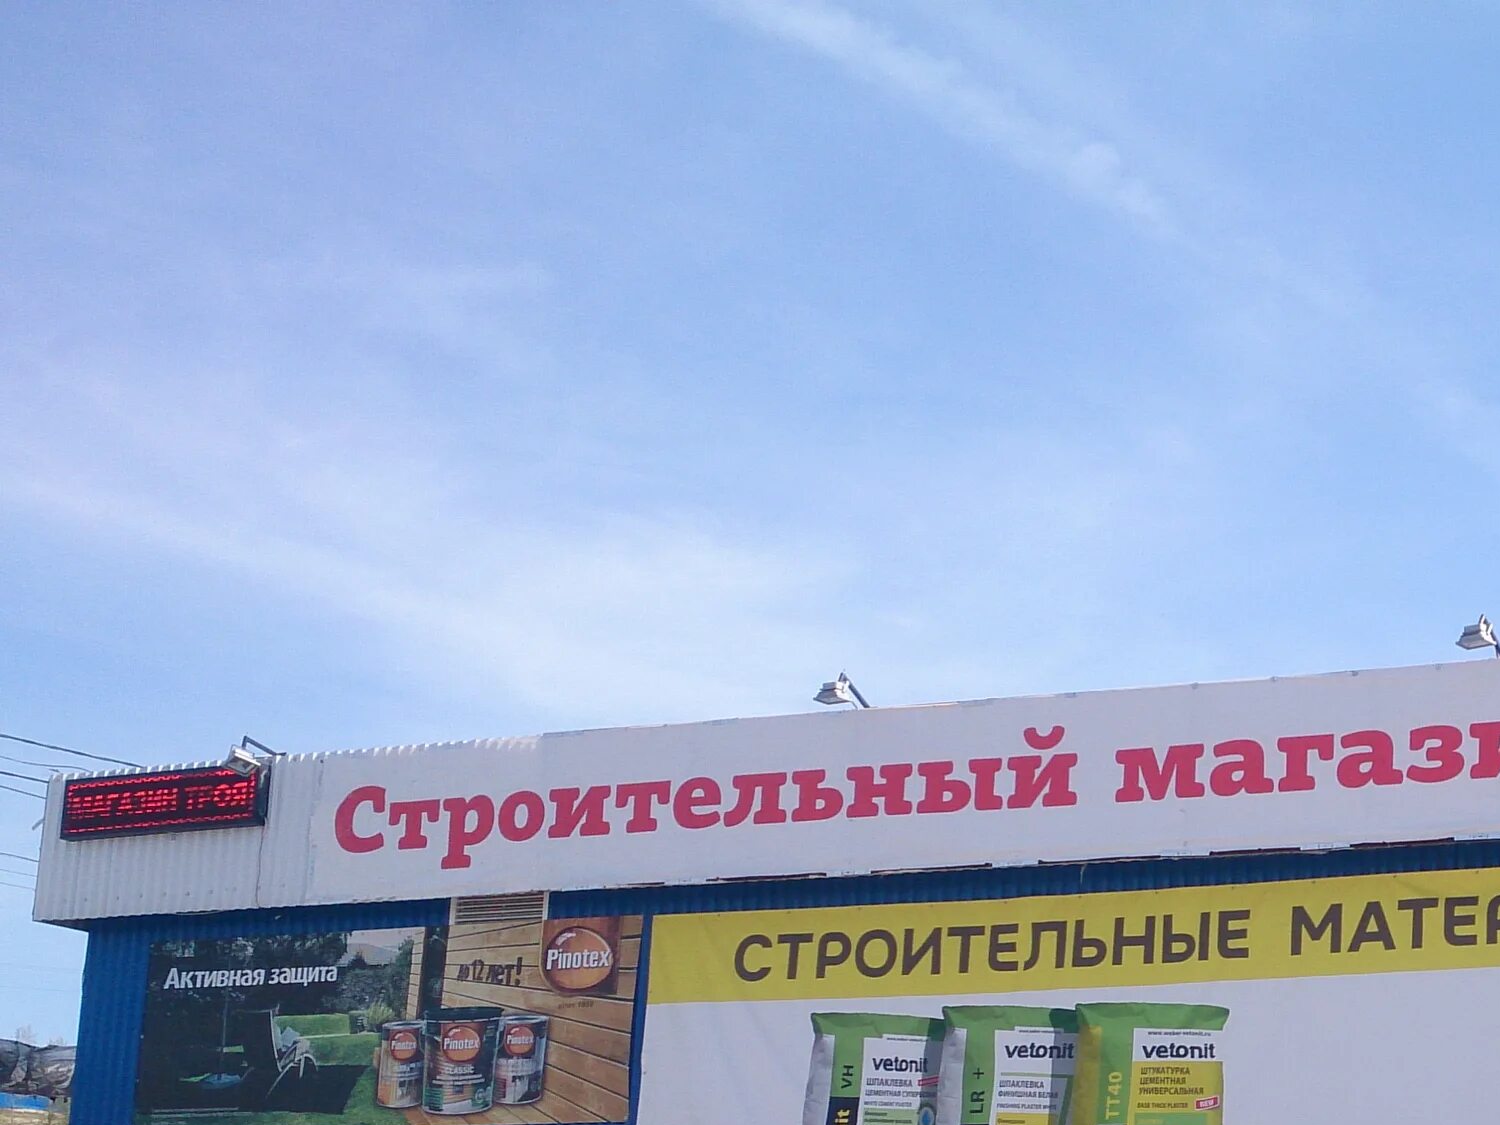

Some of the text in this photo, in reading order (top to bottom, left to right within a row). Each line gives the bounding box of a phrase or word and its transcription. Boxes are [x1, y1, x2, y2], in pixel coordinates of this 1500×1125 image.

[334, 725, 1077, 869] Строительный
[733, 909, 1251, 982] СТРОИТЕЛЬНЫЕ
[546, 948, 611, 971] Pinotex
[163, 965, 338, 990] Активная защита
[443, 1037, 481, 1050] Pinotex
[1004, 1042, 1075, 1060] vetonit
[1142, 1042, 1216, 1060] vetonit
[872, 1056, 929, 1073] vetonit
[1140, 1066, 1191, 1076] ШТУКАТУРКА
[999, 1079, 1045, 1089] ШПАКЛЕВКА
[1139, 1076, 1187, 1086] ЦЕМЕНТНАЯ
[1138, 1086, 1204, 1096] УНИВЕРСАЛЬНАЯ
